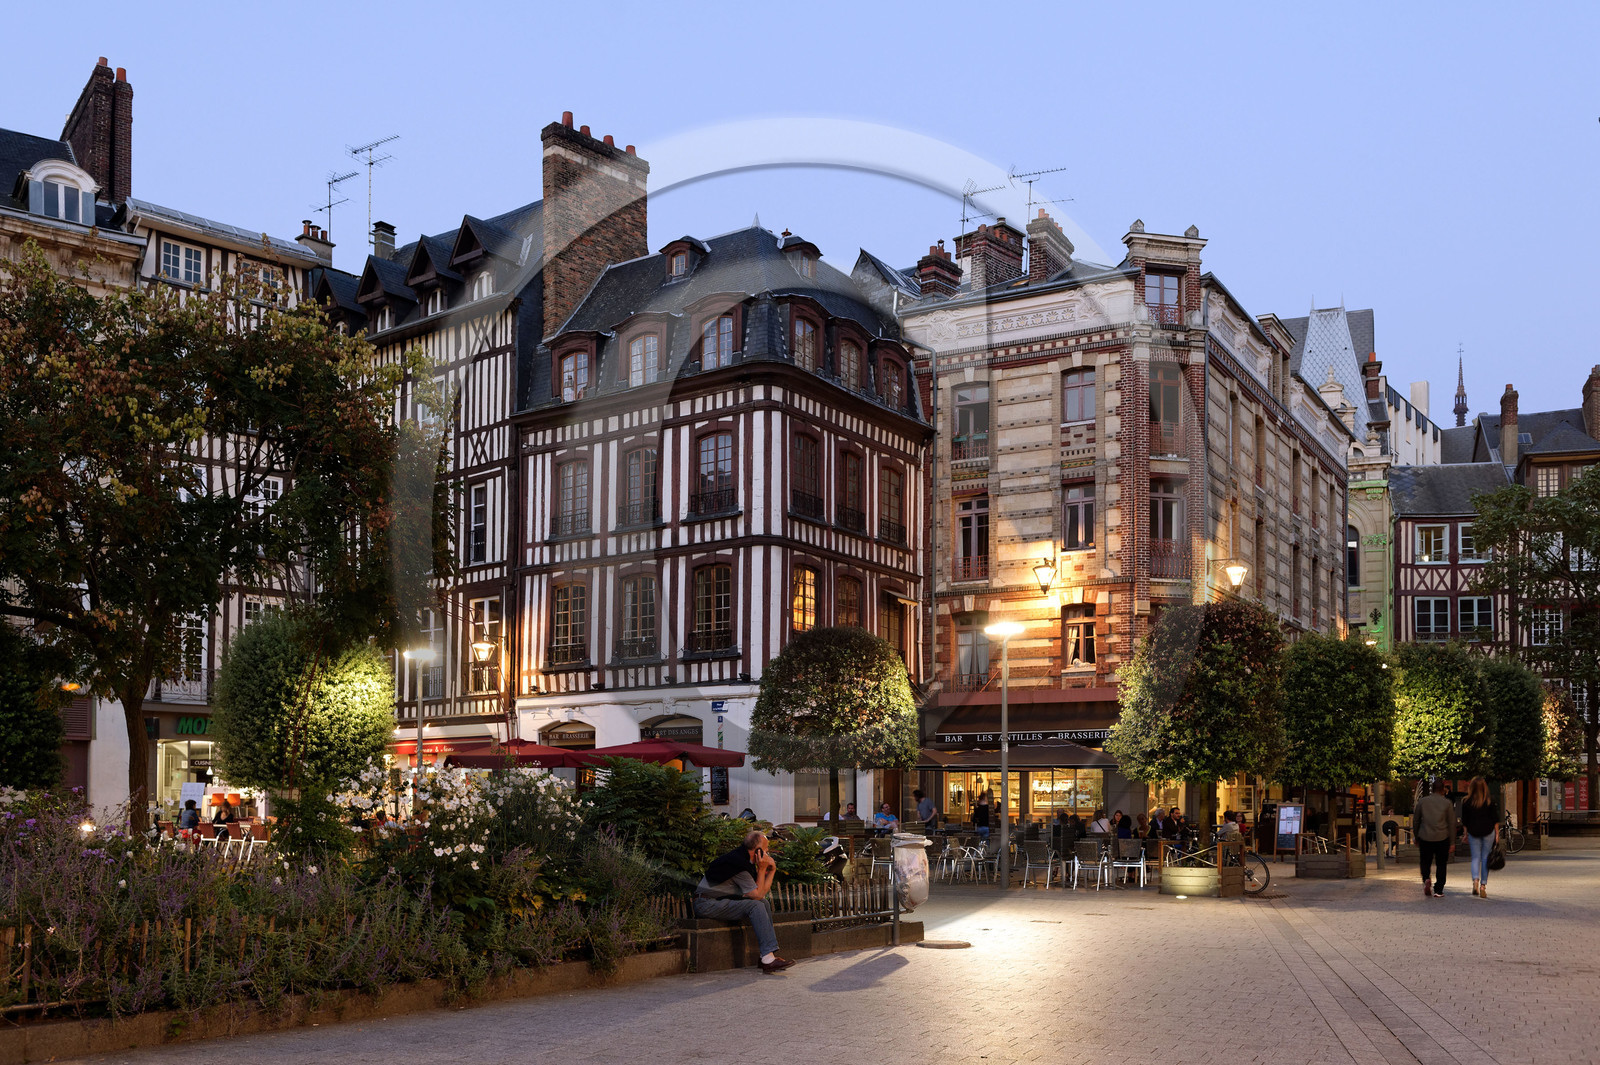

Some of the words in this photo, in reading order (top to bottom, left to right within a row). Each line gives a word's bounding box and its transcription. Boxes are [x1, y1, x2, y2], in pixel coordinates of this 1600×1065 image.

[945, 735, 963, 743] BAR
[976, 734, 993, 742] LES
[1058, 731, 1110, 740] BRASSERIE
